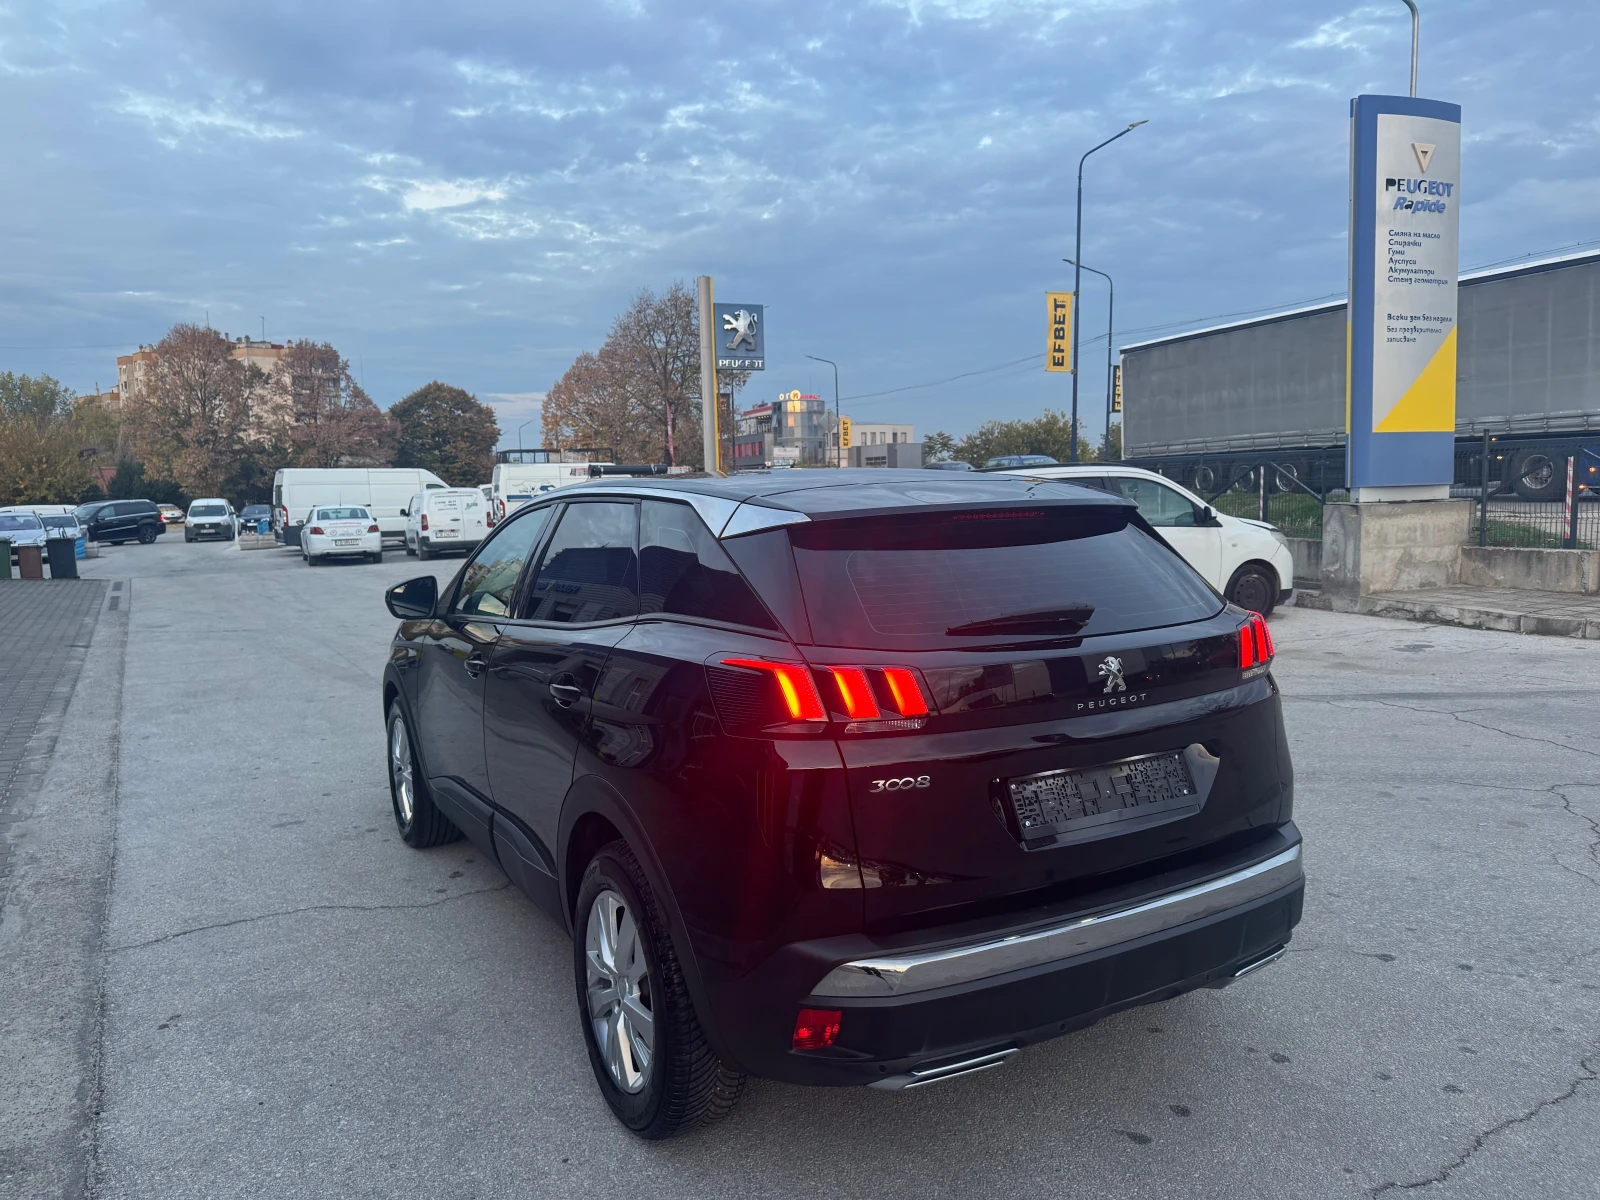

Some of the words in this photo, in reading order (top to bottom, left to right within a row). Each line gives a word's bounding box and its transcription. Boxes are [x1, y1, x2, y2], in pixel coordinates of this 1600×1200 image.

[1385, 178, 1453, 197] PEUGEOT
[1393, 196, 1446, 214] Rapide
[1388, 229, 1412, 237] Смяна
[1388, 239, 1422, 248] Спирачки
[1388, 248, 1405, 256] Гуми
[1388, 257, 1417, 266] Ауспуси
[1388, 266, 1435, 276] Акумулатори
[1388, 275, 1413, 284] Стенд
[1387, 313, 1408, 321] Всеки
[1052, 297, 1066, 367] EFBET
[718, 359, 764, 368] PEUGEOT
[1077, 693, 1147, 711] PEUGEOT
[869, 775, 931, 793] 3008
